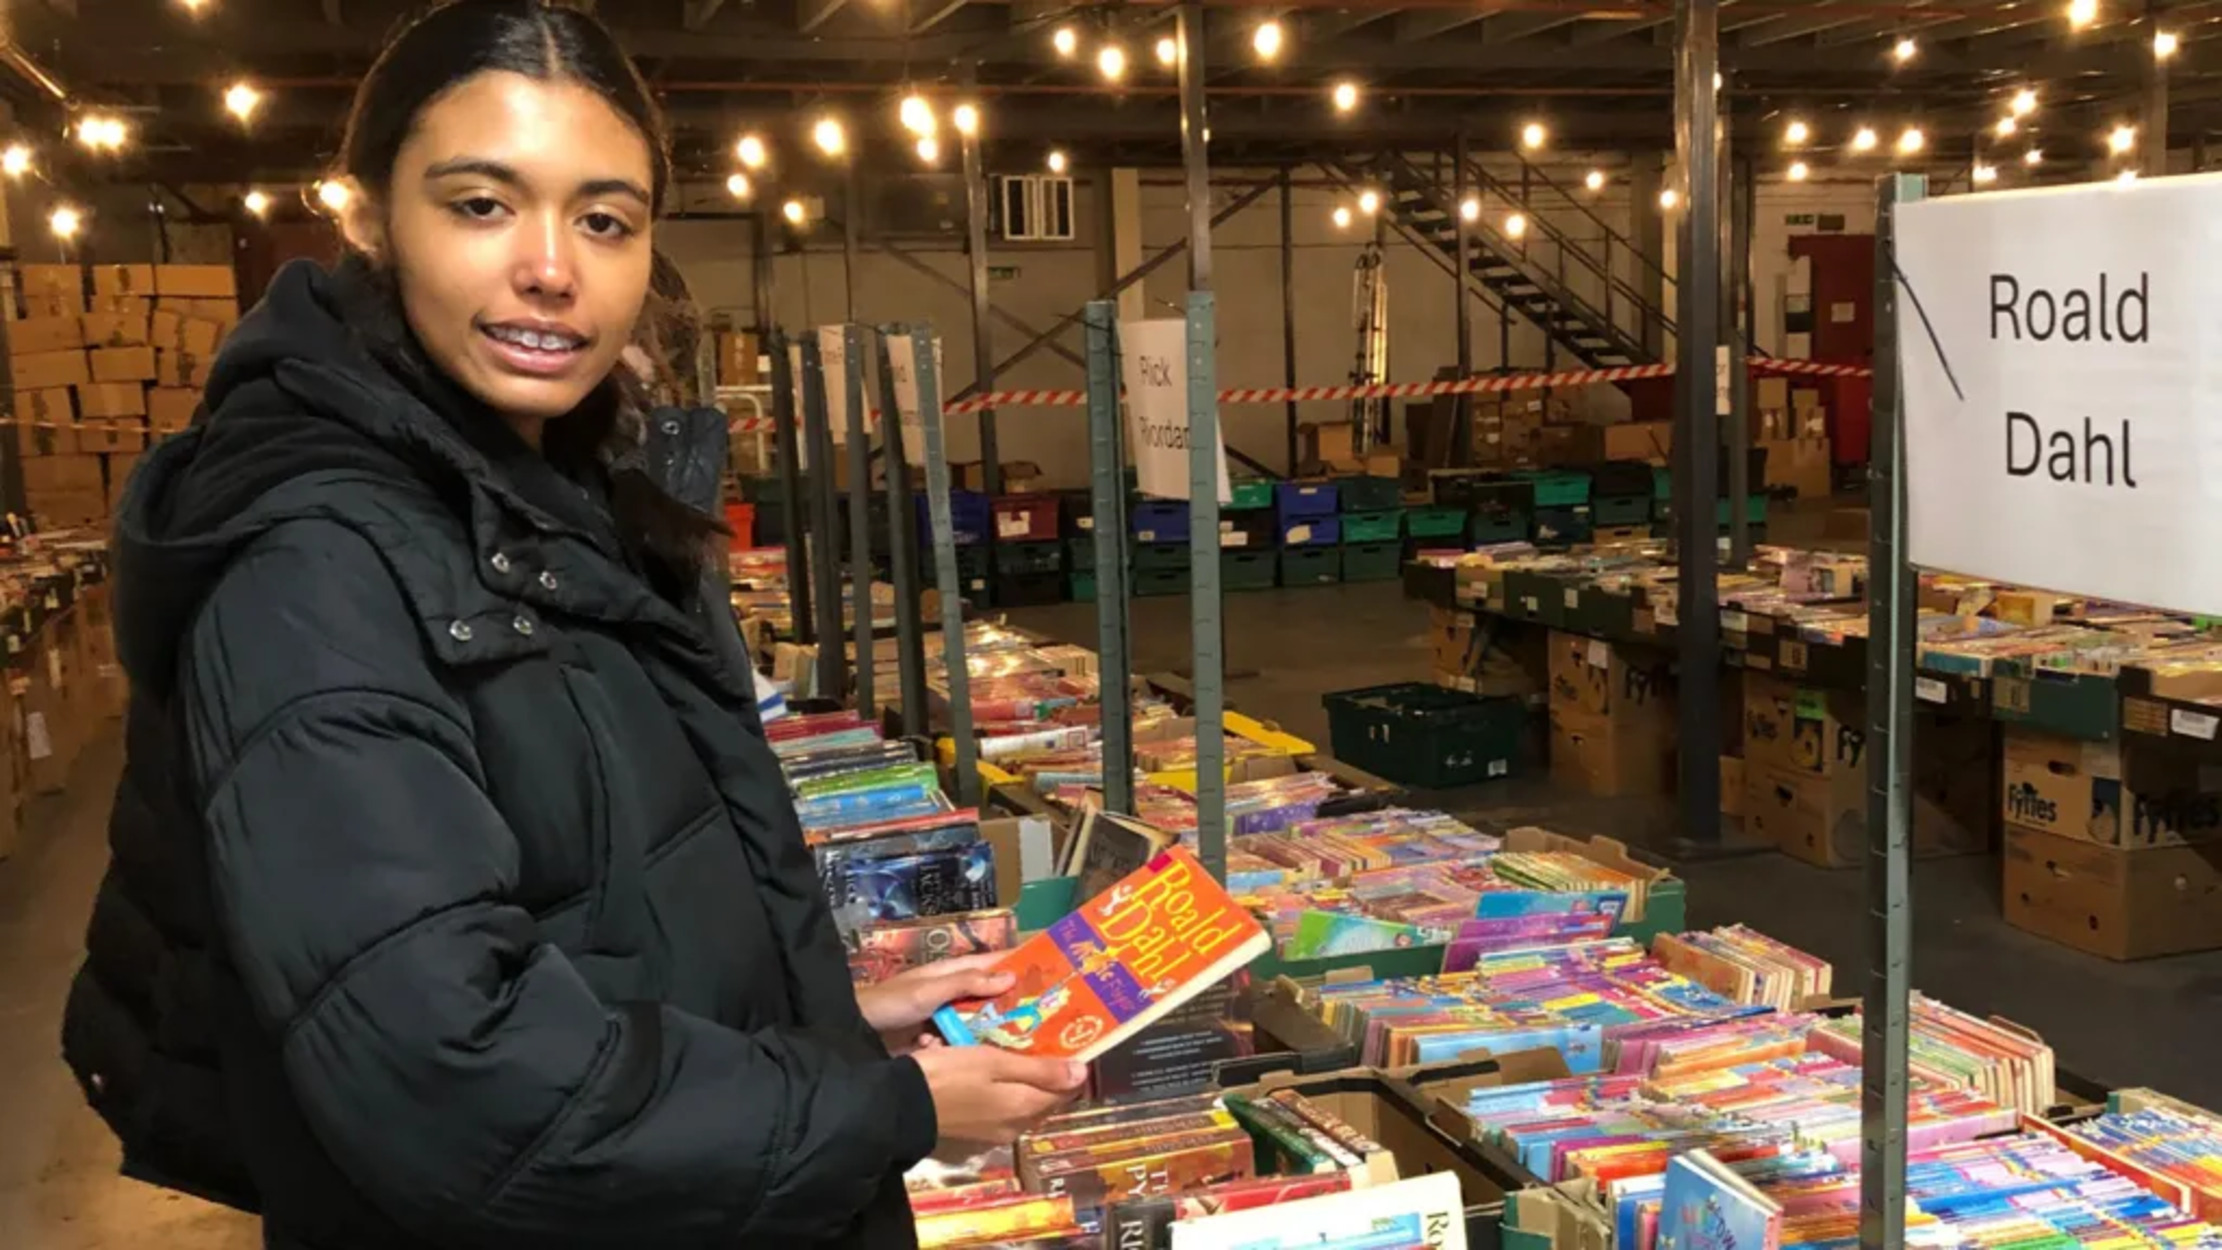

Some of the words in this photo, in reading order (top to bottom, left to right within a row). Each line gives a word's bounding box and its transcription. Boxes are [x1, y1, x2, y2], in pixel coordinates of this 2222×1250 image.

[1989, 271, 2150, 344] Roald
[1139, 355, 1173, 388] Rick
[2005, 411, 2138, 489] Dahl
[1098, 896, 1194, 983] Dahl
[1132, 858, 1242, 956] Roald
[1426, 1211, 1450, 1249] Ro
